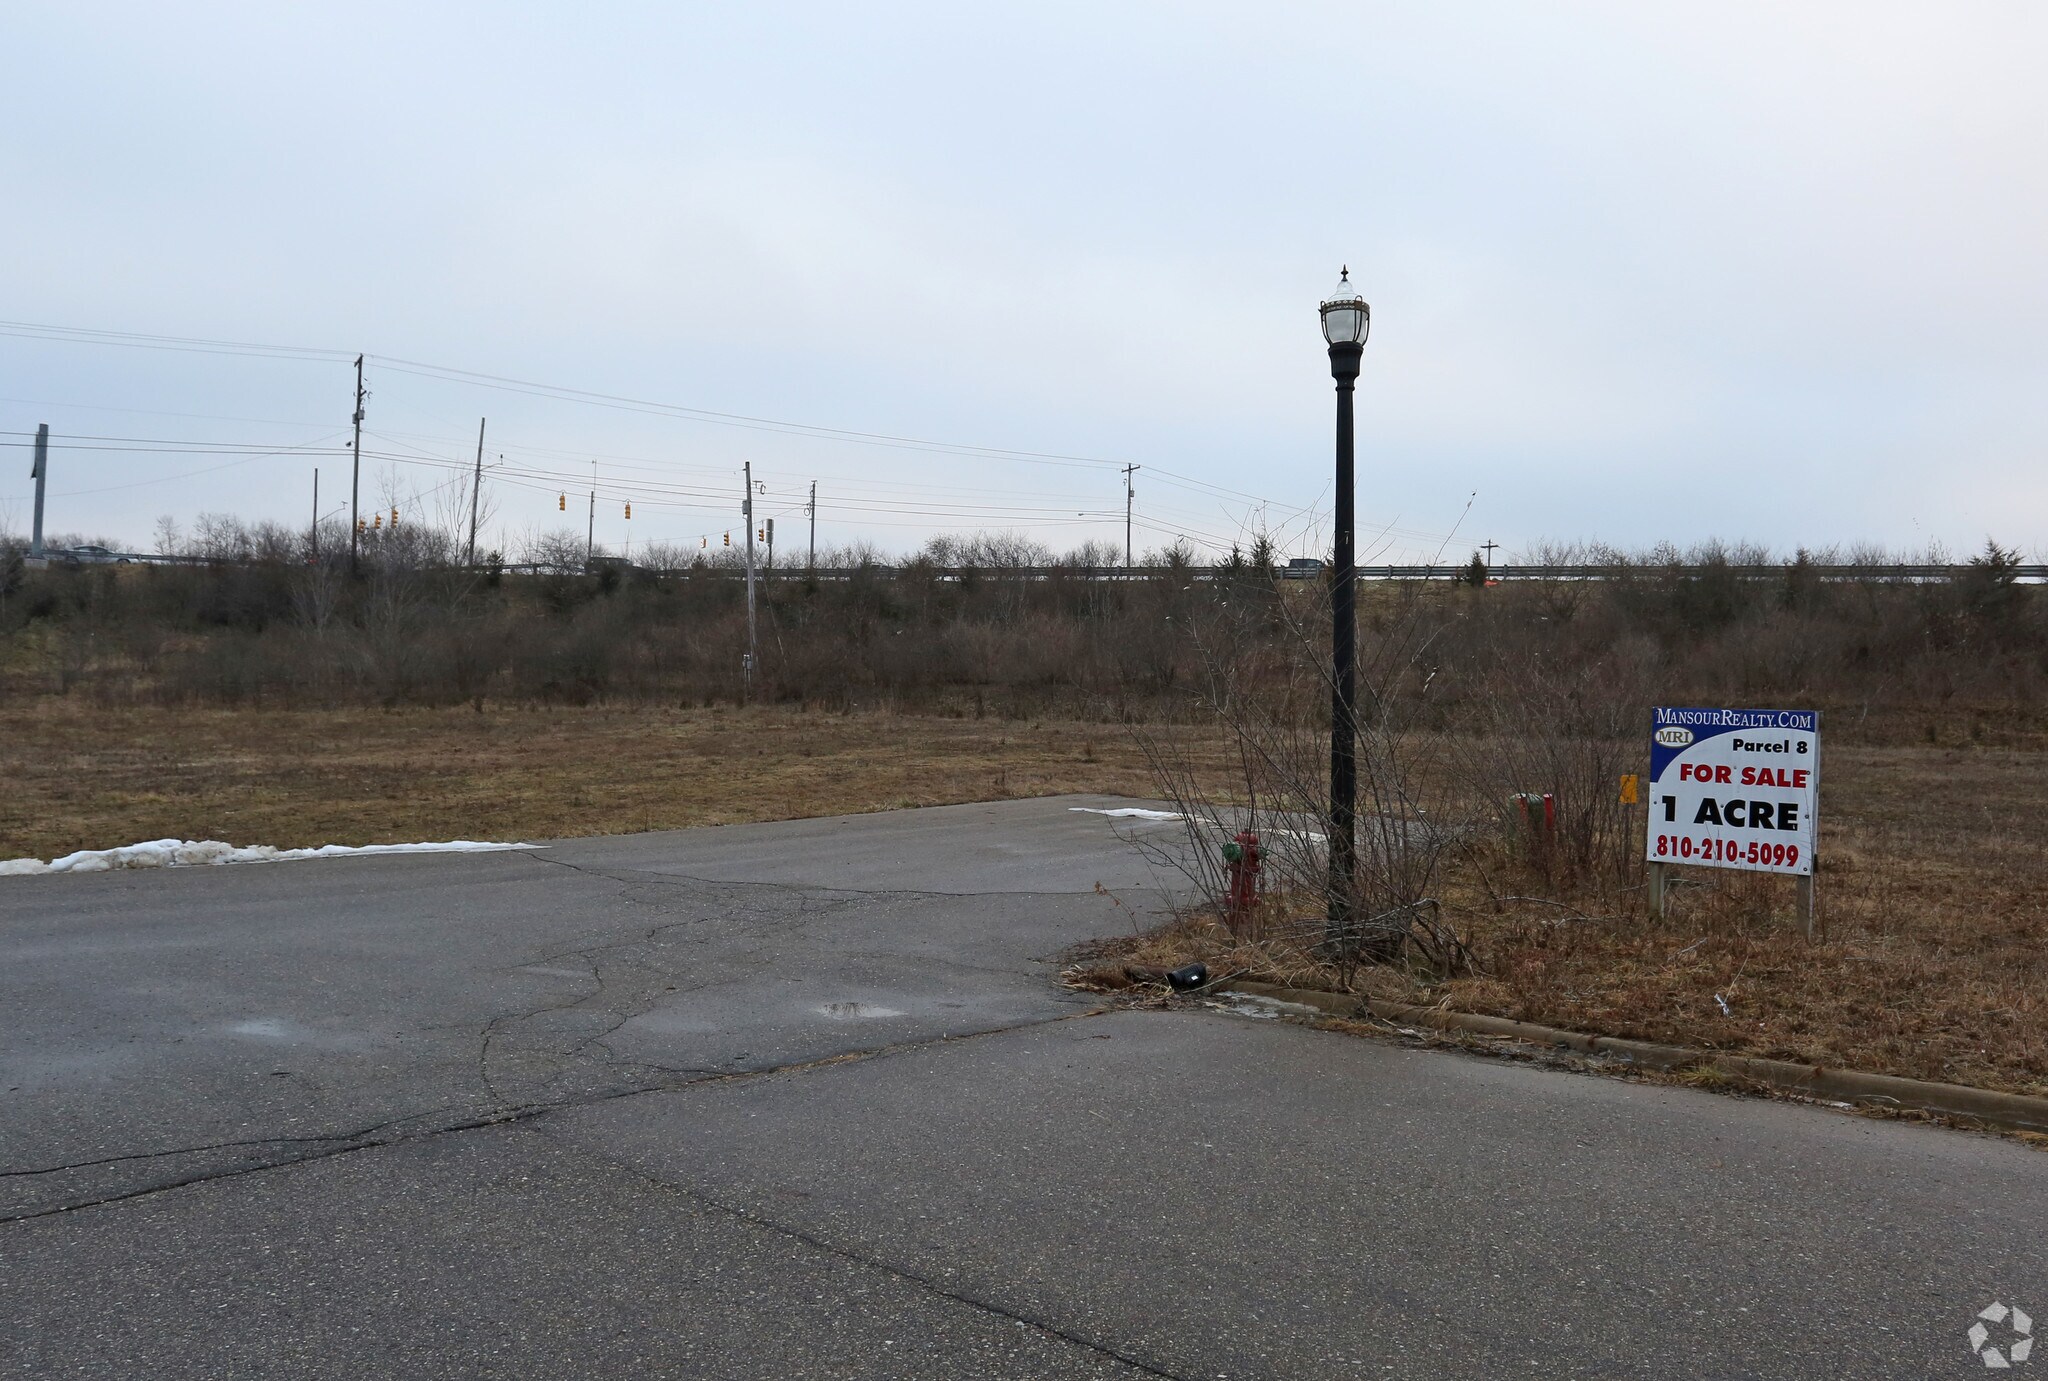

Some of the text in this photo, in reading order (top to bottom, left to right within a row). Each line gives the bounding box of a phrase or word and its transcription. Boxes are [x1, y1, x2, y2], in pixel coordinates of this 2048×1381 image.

[1658, 731, 1690, 744] MRI
[1732, 738, 1808, 754] Parcel 8
[1680, 763, 1807, 789] FOR SALE
[1661, 795, 1799, 831] 1 ACRE
[1657, 834, 1799, 867] 810-210-5099
